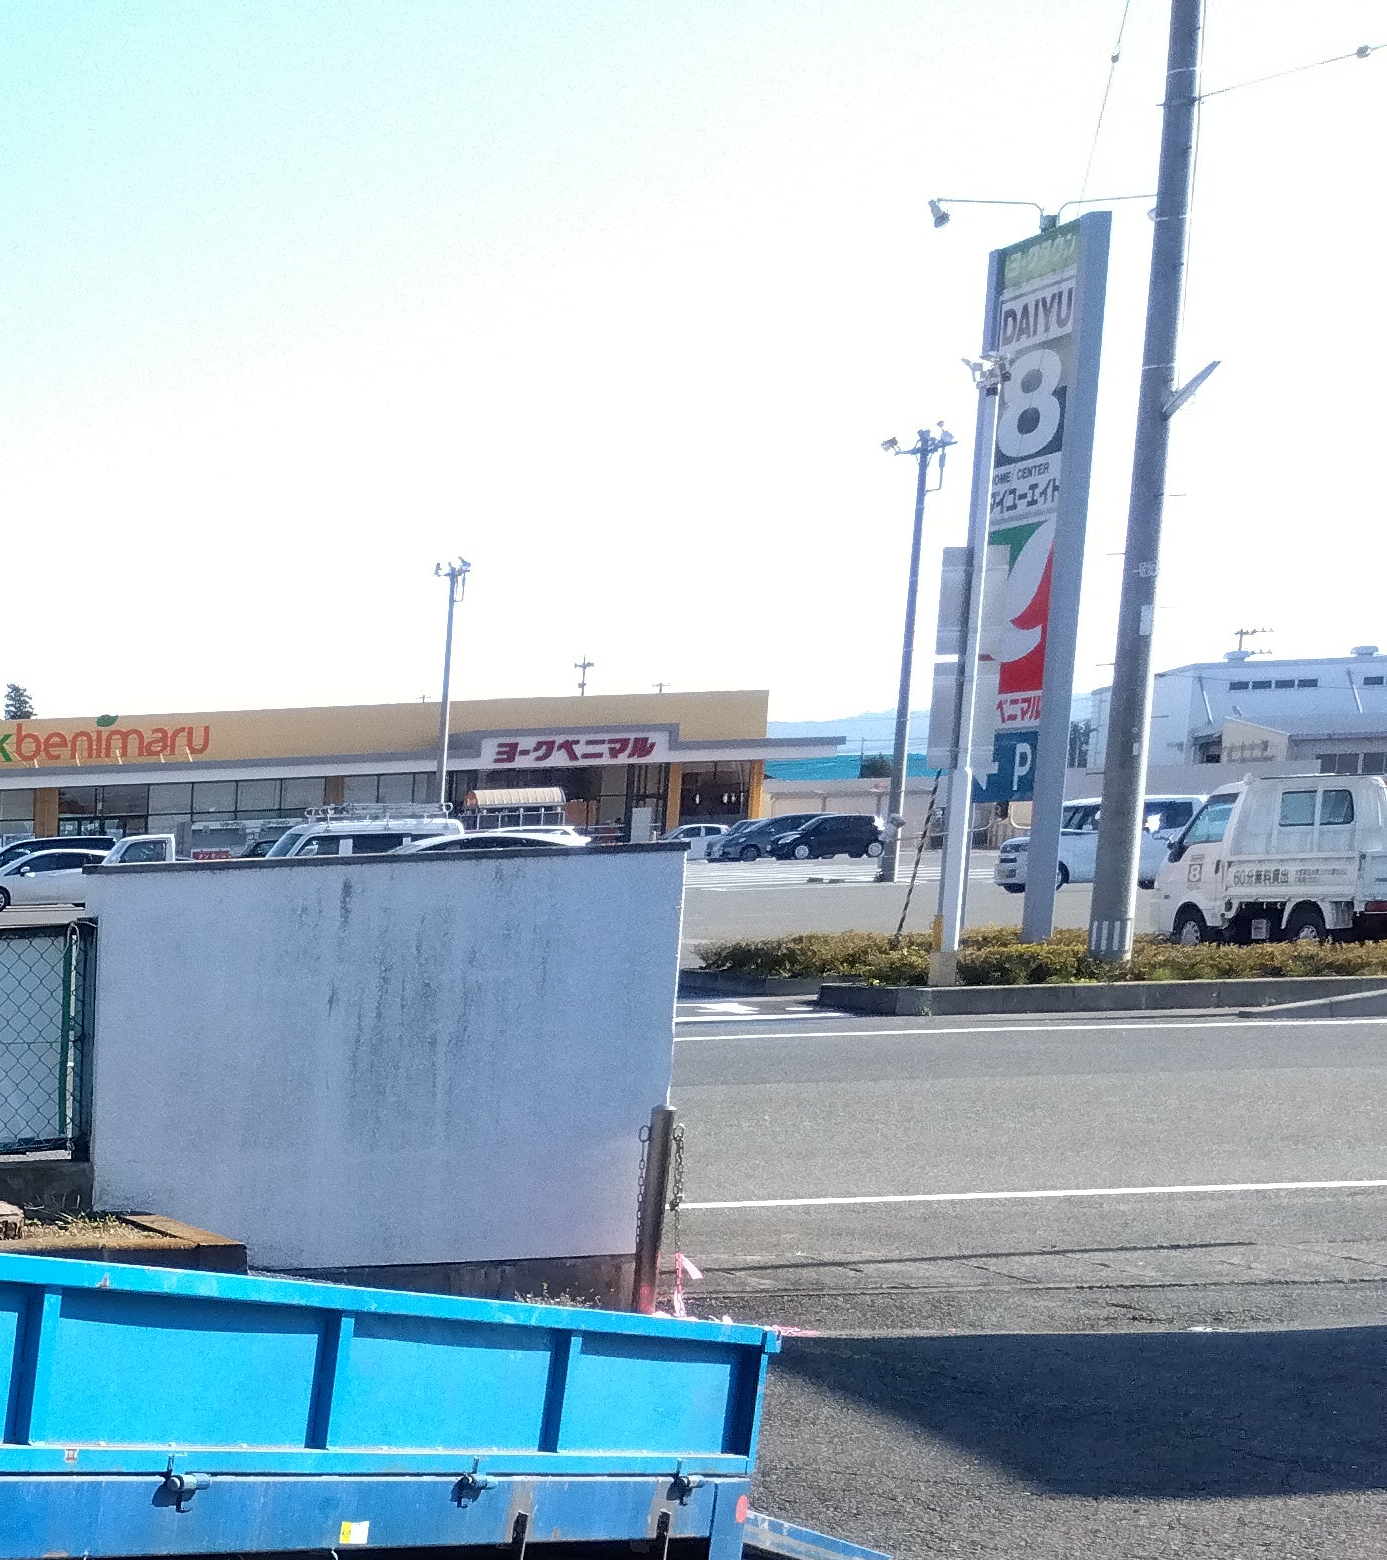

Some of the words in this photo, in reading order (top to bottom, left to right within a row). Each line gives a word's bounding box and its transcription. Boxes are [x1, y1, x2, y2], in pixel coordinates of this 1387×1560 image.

[1001, 287, 1073, 348] DAIYU
[996, 348, 1062, 458] 8
[1016, 461, 1050, 481] CENTER
[493, 737, 657, 763] ヨークベニマル
[1012, 742, 1032, 791] P
